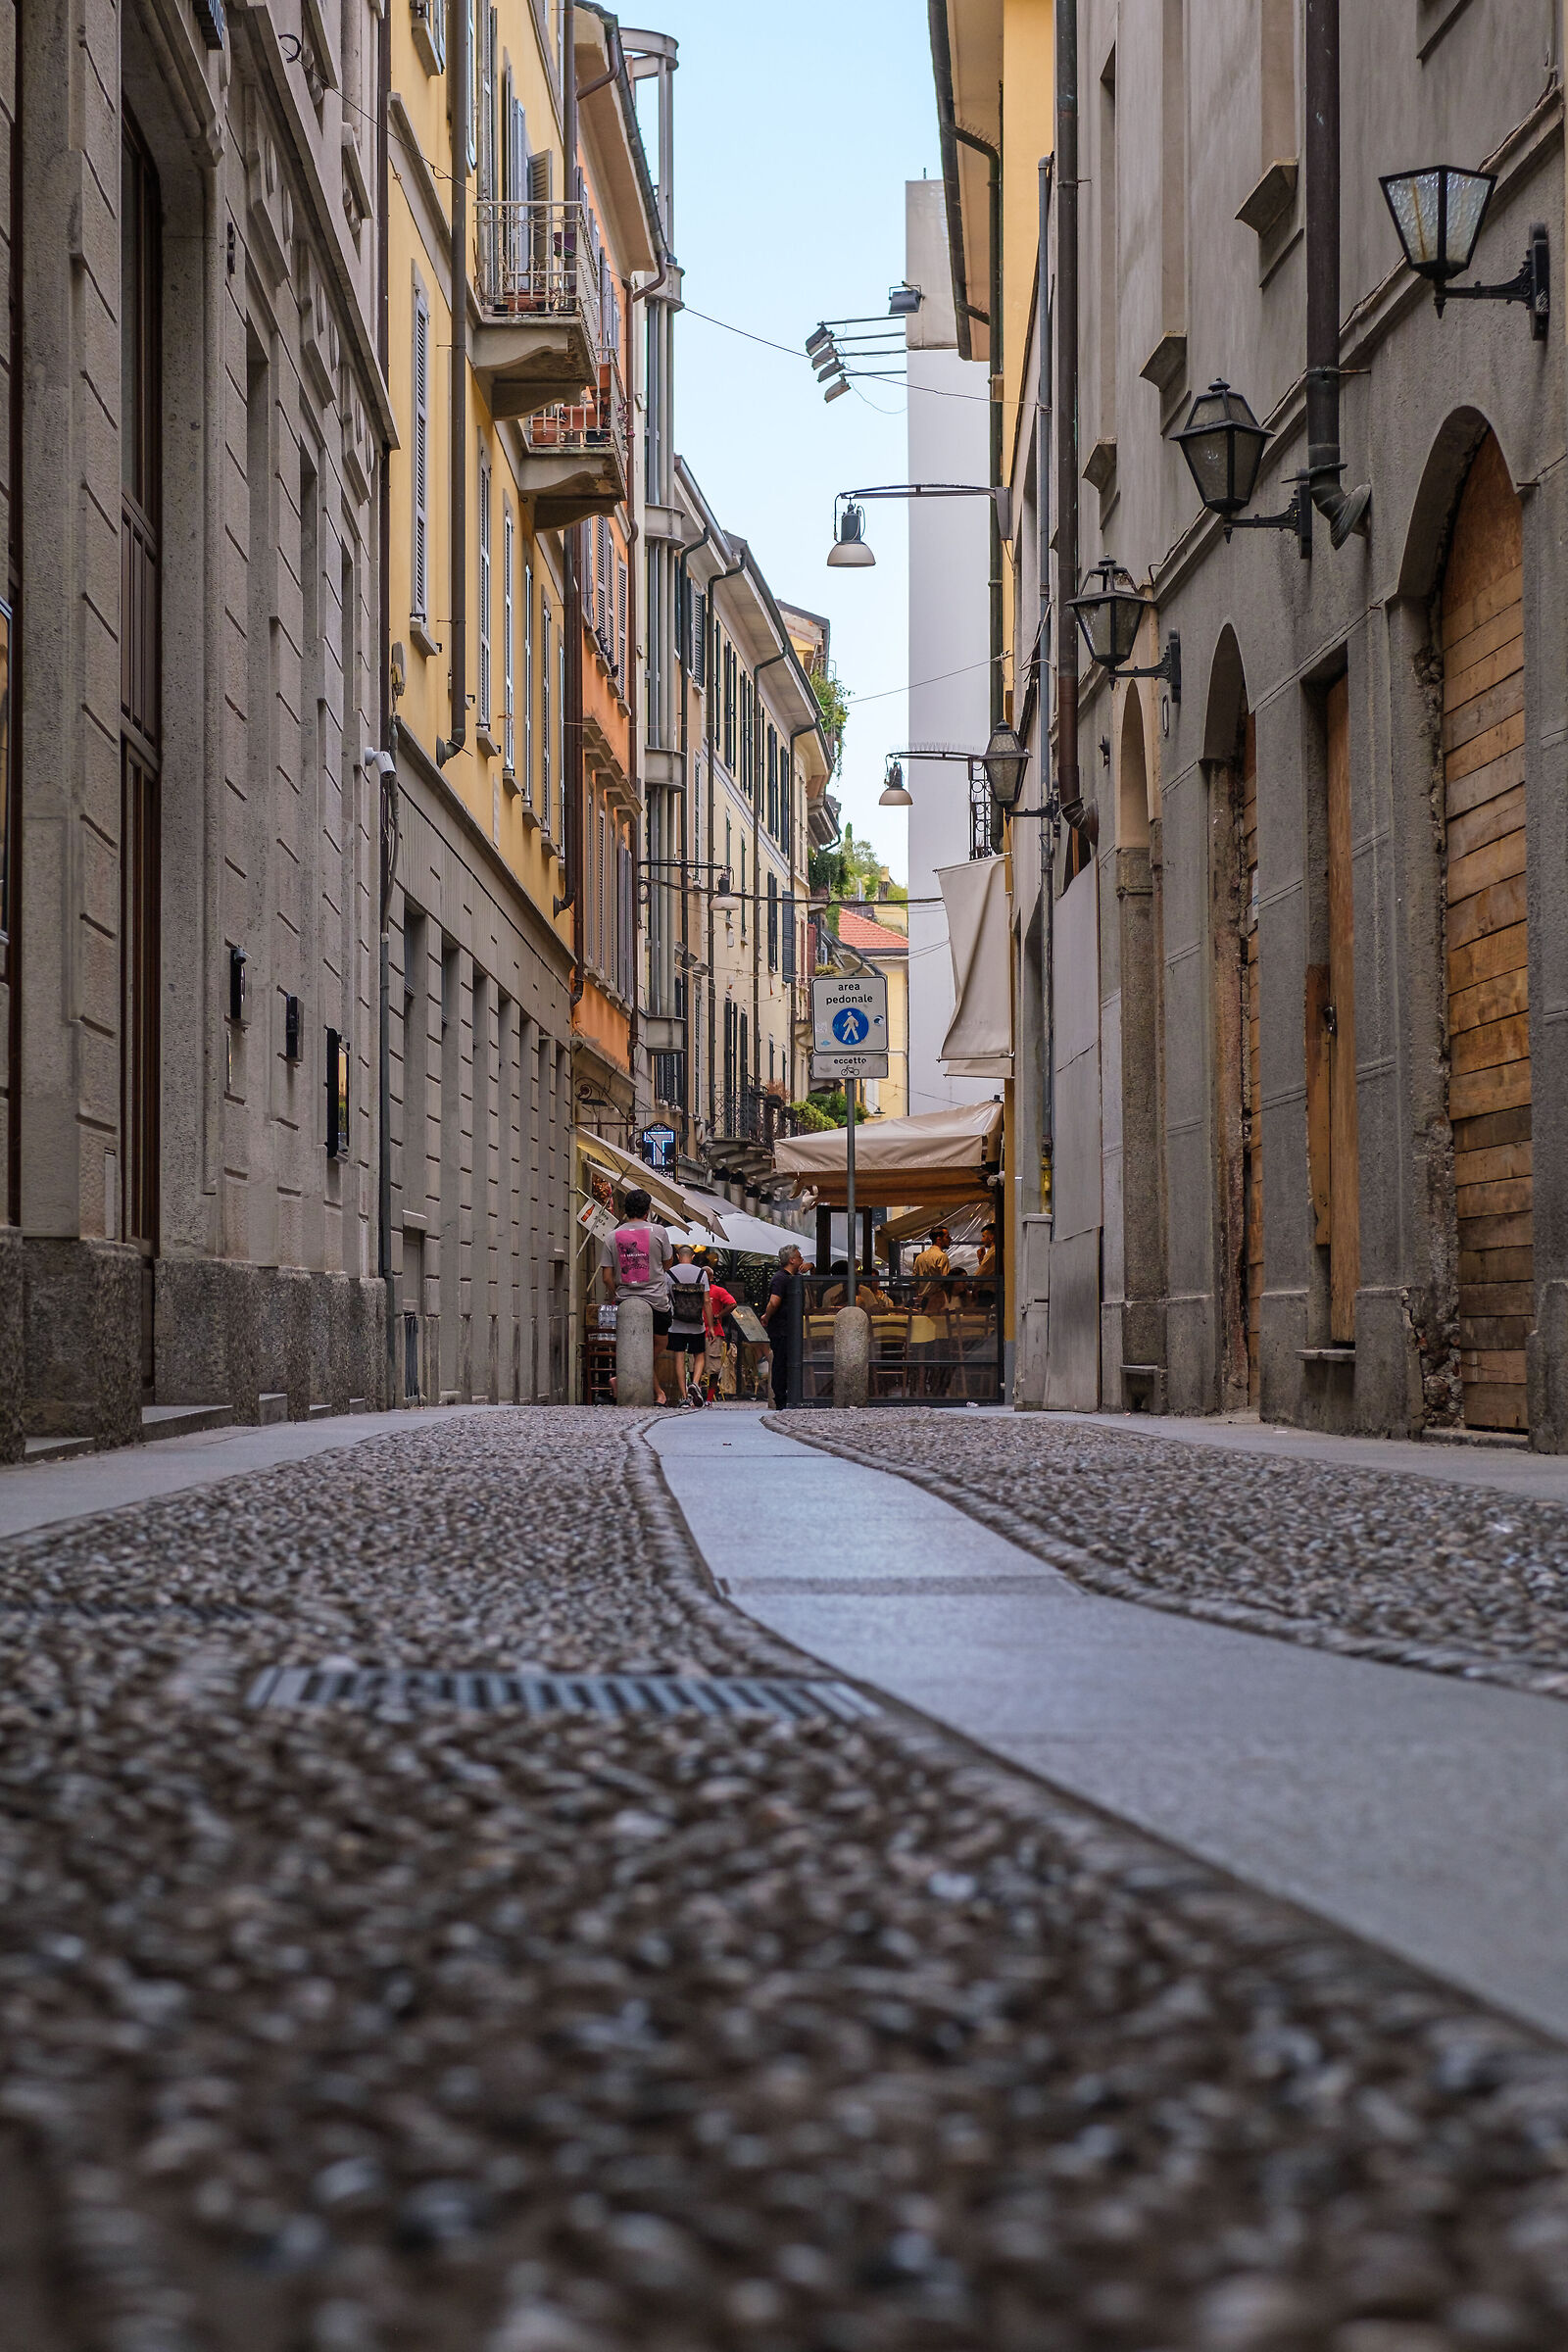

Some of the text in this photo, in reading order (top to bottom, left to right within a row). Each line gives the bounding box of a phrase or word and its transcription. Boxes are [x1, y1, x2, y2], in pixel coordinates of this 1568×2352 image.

[838, 983, 860, 992] area
[826, 994, 873, 1004] pedonale
[644, 1131, 674, 1165] T
